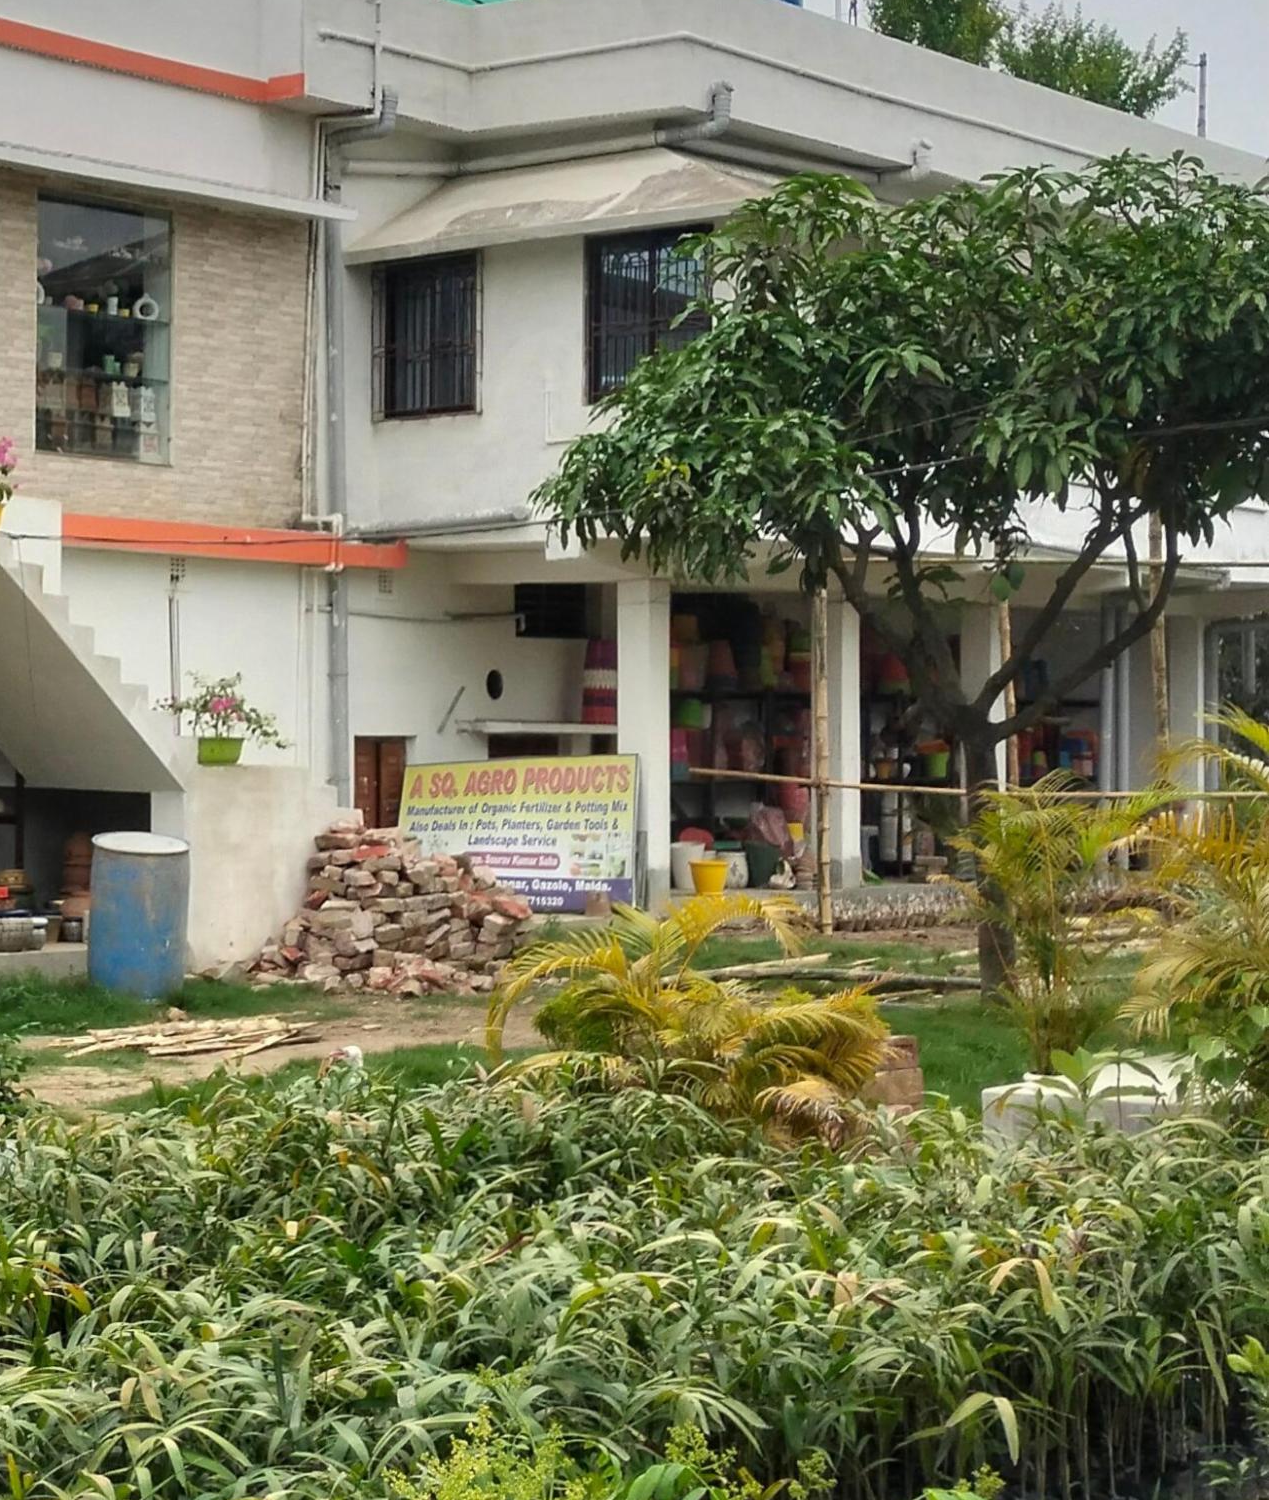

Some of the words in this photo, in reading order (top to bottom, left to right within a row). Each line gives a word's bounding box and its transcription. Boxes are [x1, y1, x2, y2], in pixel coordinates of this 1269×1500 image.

[410, 773, 423, 799] A
[463, 768, 516, 797] AGRO
[522, 764, 630, 795] PRODUCTS
[407, 803, 465, 816] Manufacturer
[469, 802, 478, 814] of
[481, 802, 516, 817] Organic
[519, 801, 562, 814] Fertilizer
[565, 801, 572, 813] &
[575, 801, 608, 816] Potting
[612, 800, 628, 813] Mix
[409, 821, 428, 832] Also
[431, 820, 456, 832] Deals
[475, 819, 498, 832] Pots,
[501, 818, 543, 833] Planters,
[546, 818, 580, 831] Garden
[583, 818, 608, 830] Tools
[612, 818, 619, 830] &
[468, 834, 519, 848] Landscape
[521, 834, 557, 846] Service
